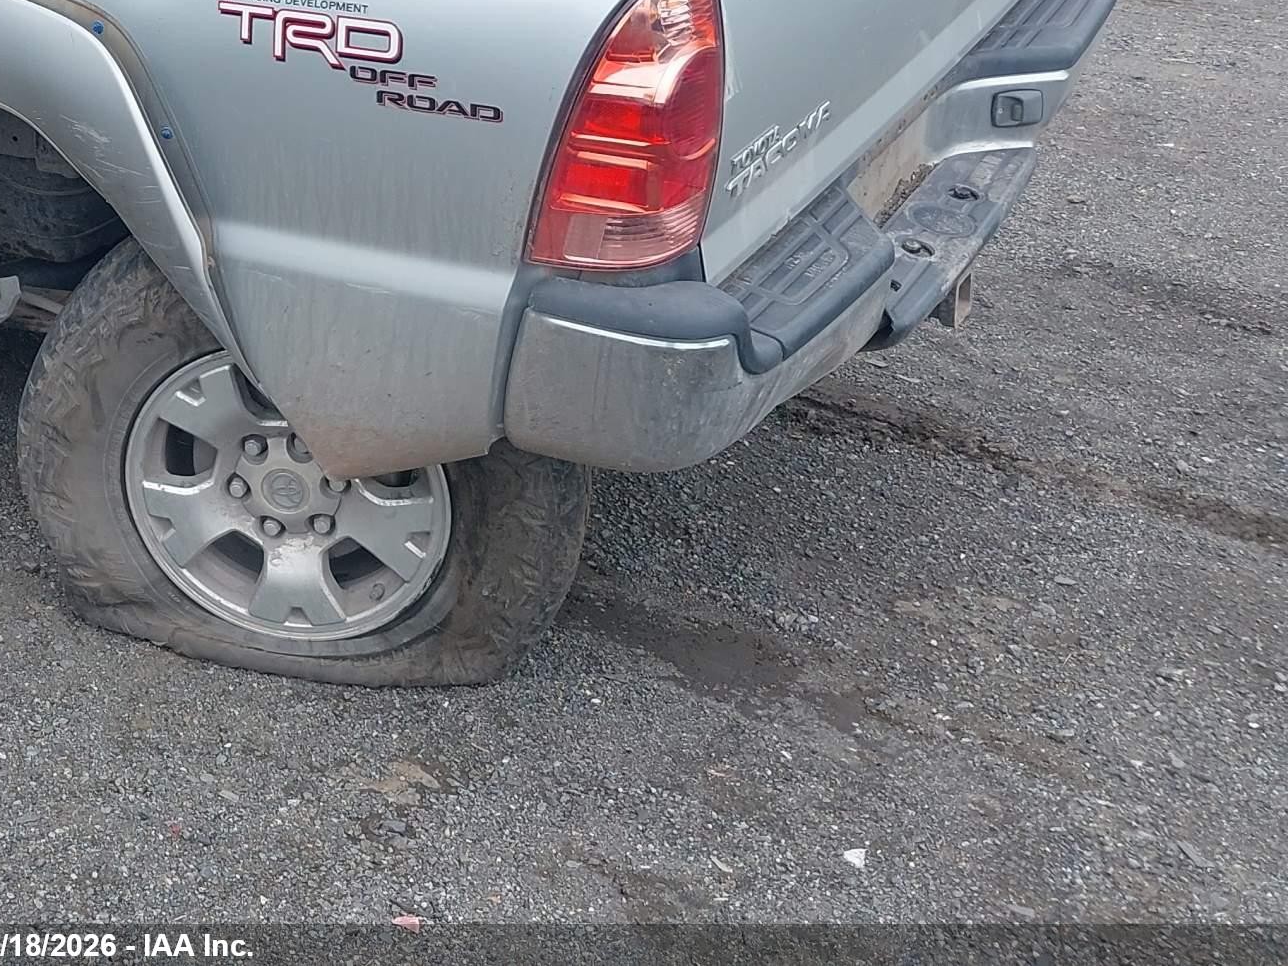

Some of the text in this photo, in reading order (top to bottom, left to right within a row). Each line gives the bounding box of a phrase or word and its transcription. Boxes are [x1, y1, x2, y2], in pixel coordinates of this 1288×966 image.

[218, 0, 402, 69] TRD
[349, 66, 437, 89] OFF
[377, 90, 503, 122] ROAD
